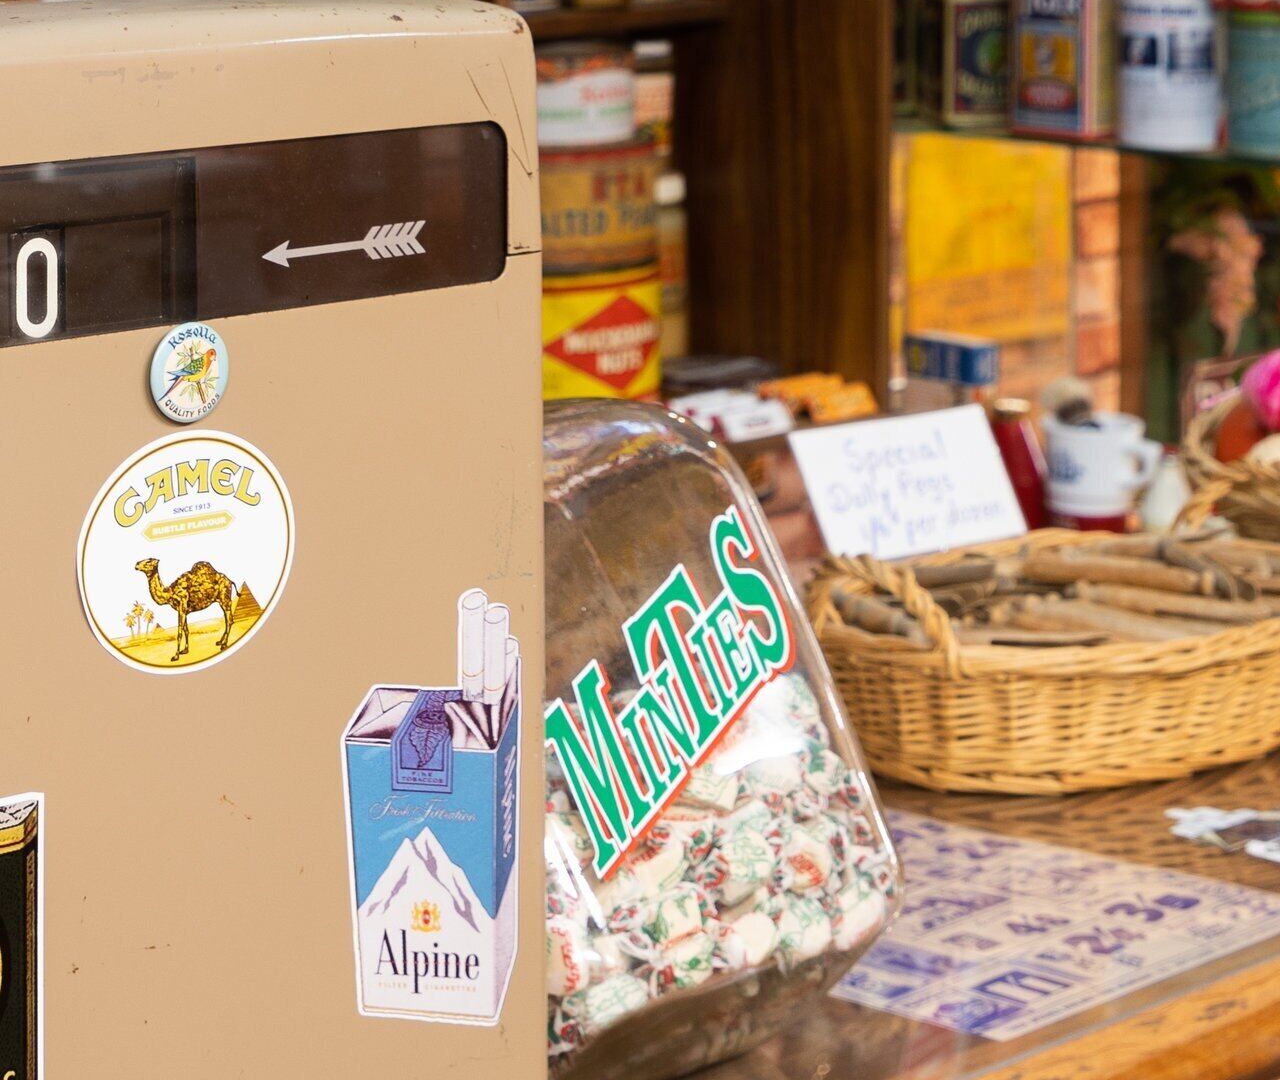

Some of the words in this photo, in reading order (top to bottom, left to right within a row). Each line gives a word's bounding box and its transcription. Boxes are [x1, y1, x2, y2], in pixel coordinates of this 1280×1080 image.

[167, 325, 218, 351] Rosella
[164, 398, 195, 419] QUALITY
[196, 392, 222, 417] FOODS
[113, 458, 262, 529] CAMEL
[172, 505, 193, 516] SINCE
[194, 501, 212, 513] 1913
[152, 522, 187, 536] SUBTLE
[187, 515, 228, 530] FLAVOUR
[374, 927, 481, 995] Alpine
